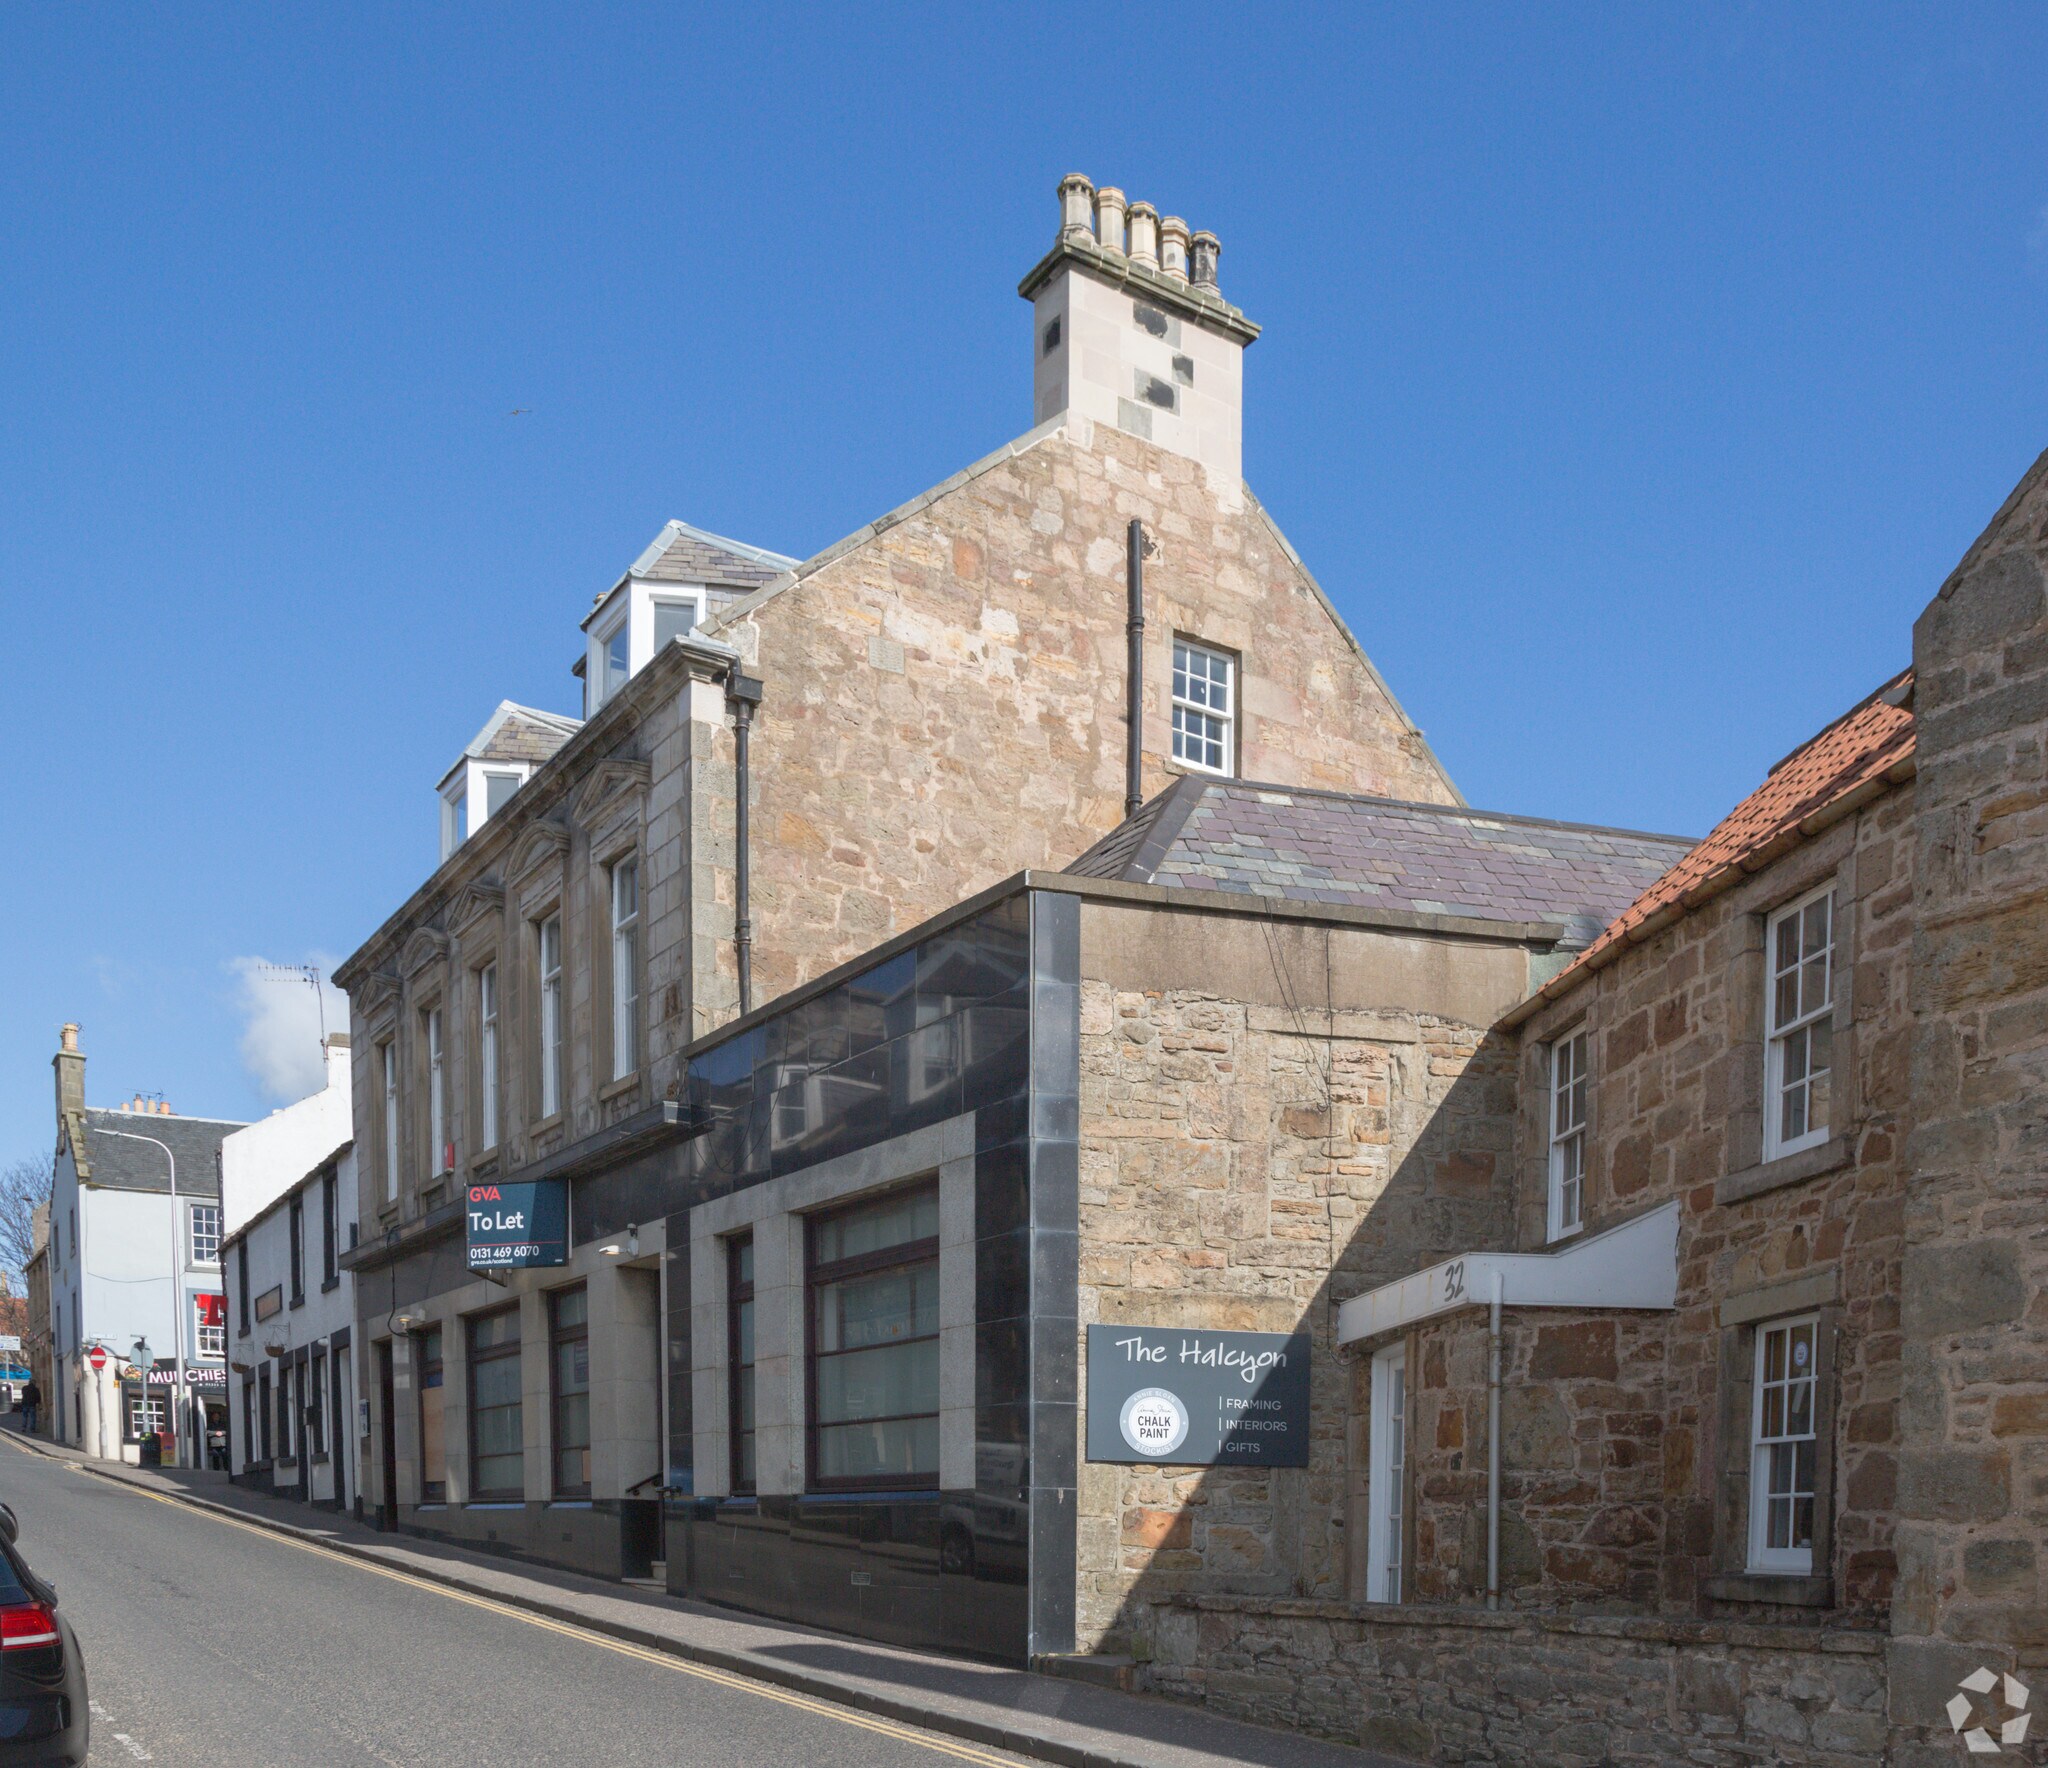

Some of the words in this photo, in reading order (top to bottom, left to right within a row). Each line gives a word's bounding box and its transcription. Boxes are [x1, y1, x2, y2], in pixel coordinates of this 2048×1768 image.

[469, 1186, 501, 1202] GVA
[469, 1212, 492, 1231] To
[496, 1211, 524, 1230] Let
[470, 1247, 491, 1259] 0131
[493, 1246, 511, 1258] 469
[513, 1245, 540, 1257] 6070
[1444, 1260, 1464, 1302] 32
[1115, 1336, 1167, 1363] The
[1179, 1338, 1287, 1383] Halcyon
[149, 1369, 227, 1384] MUCHIES
[1133, 1390, 1153, 1403] ANNIE
[1154, 1391, 1176, 1403] SLOAN
[1226, 1398, 1282, 1411] FRAMING
[1137, 1415, 1171, 1427] CHALK
[1226, 1420, 1288, 1432] INTERIORS
[1139, 1428, 1170, 1439] PAINT
[1134, 1442, 1175, 1455] STOCKIST
[1226, 1442, 1261, 1454] GIFTS
